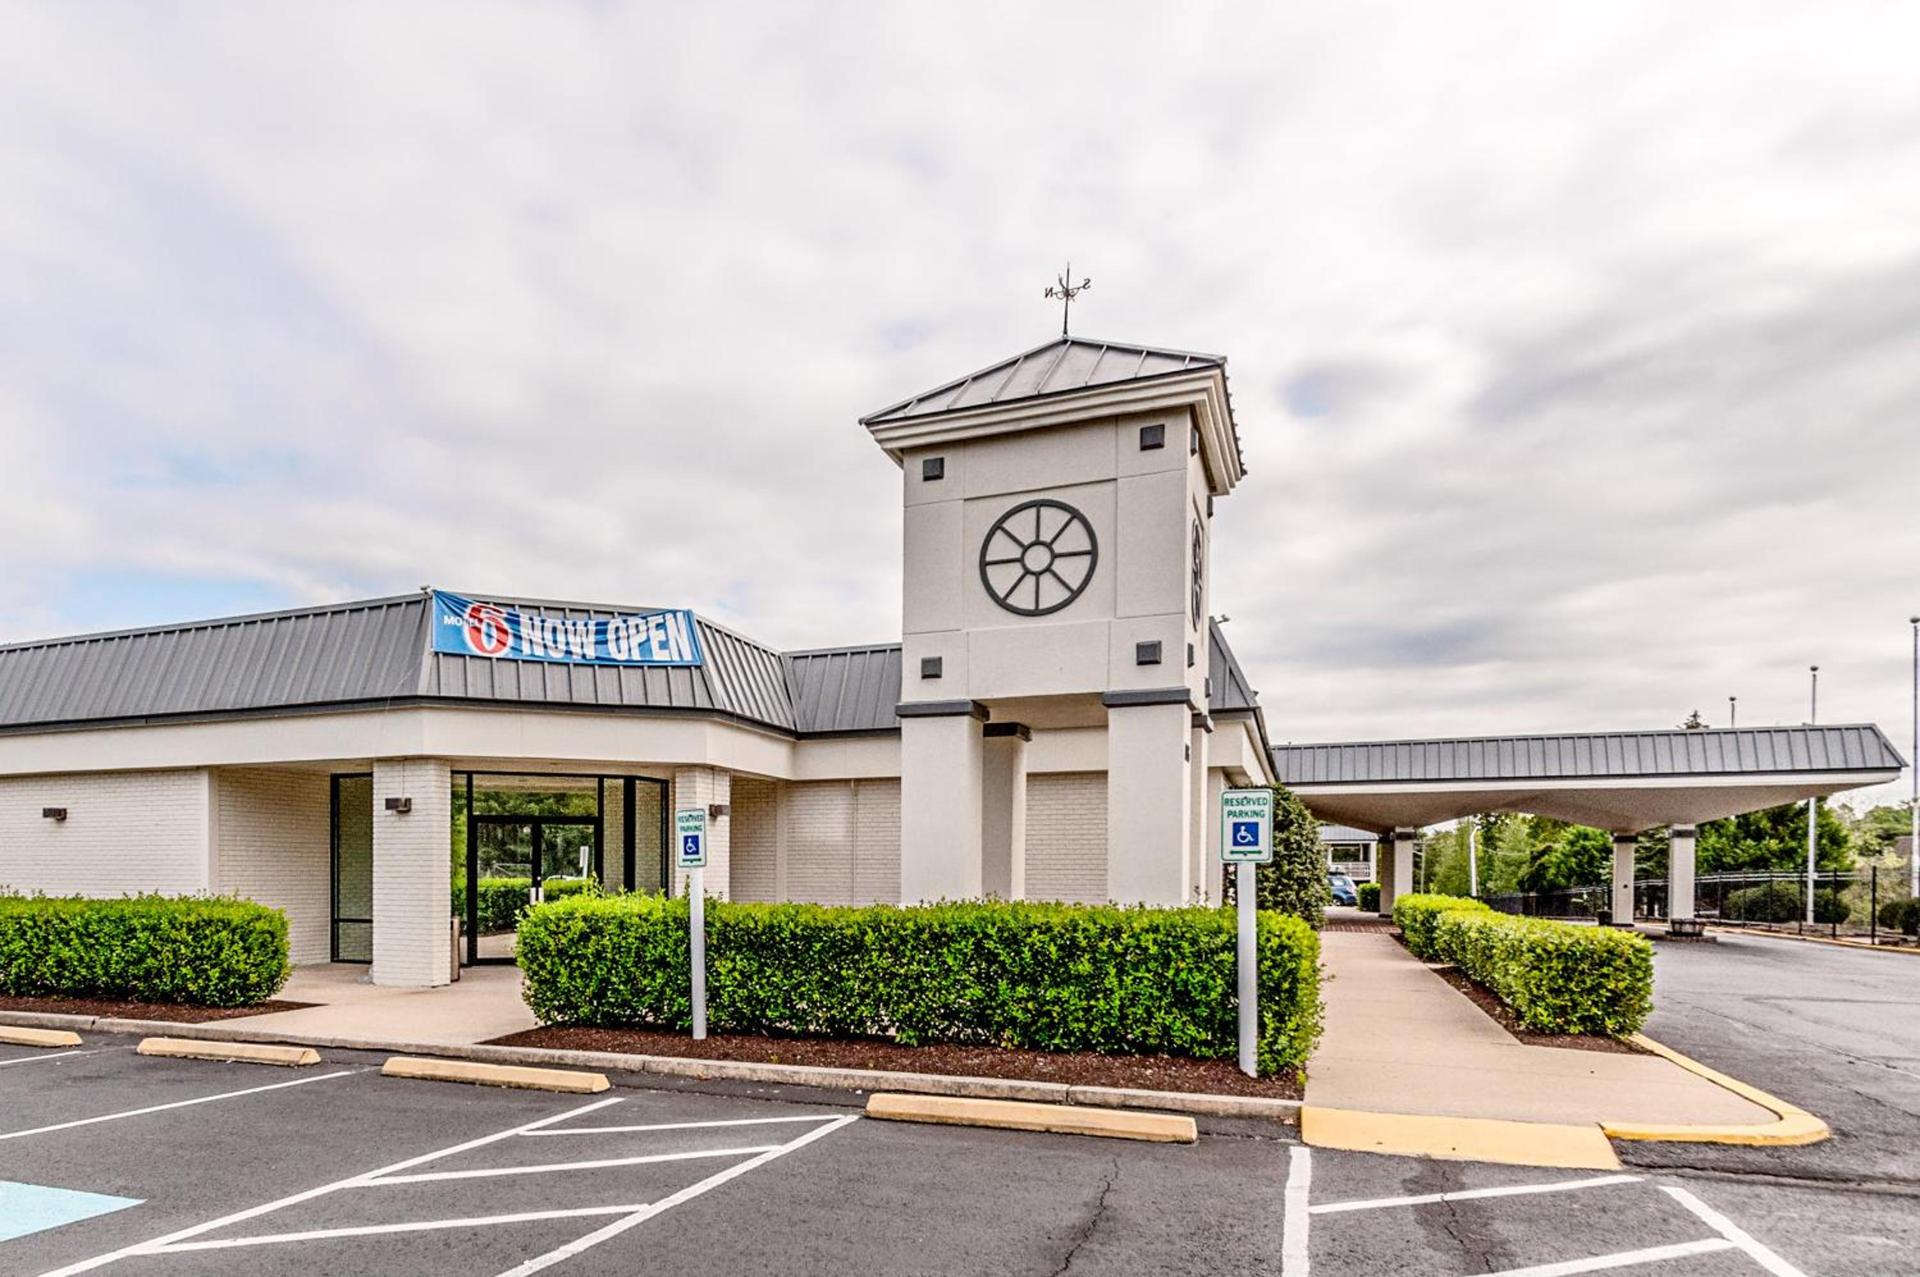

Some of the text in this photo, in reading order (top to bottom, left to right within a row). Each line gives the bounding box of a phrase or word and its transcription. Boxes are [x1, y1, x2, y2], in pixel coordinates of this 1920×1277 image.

[465, 603, 512, 656] 6
[519, 612, 596, 660] NOW
[606, 612, 693, 661] OPEN
[1224, 797, 1268, 807] RESERVED
[1227, 810, 1265, 818] PARKING
